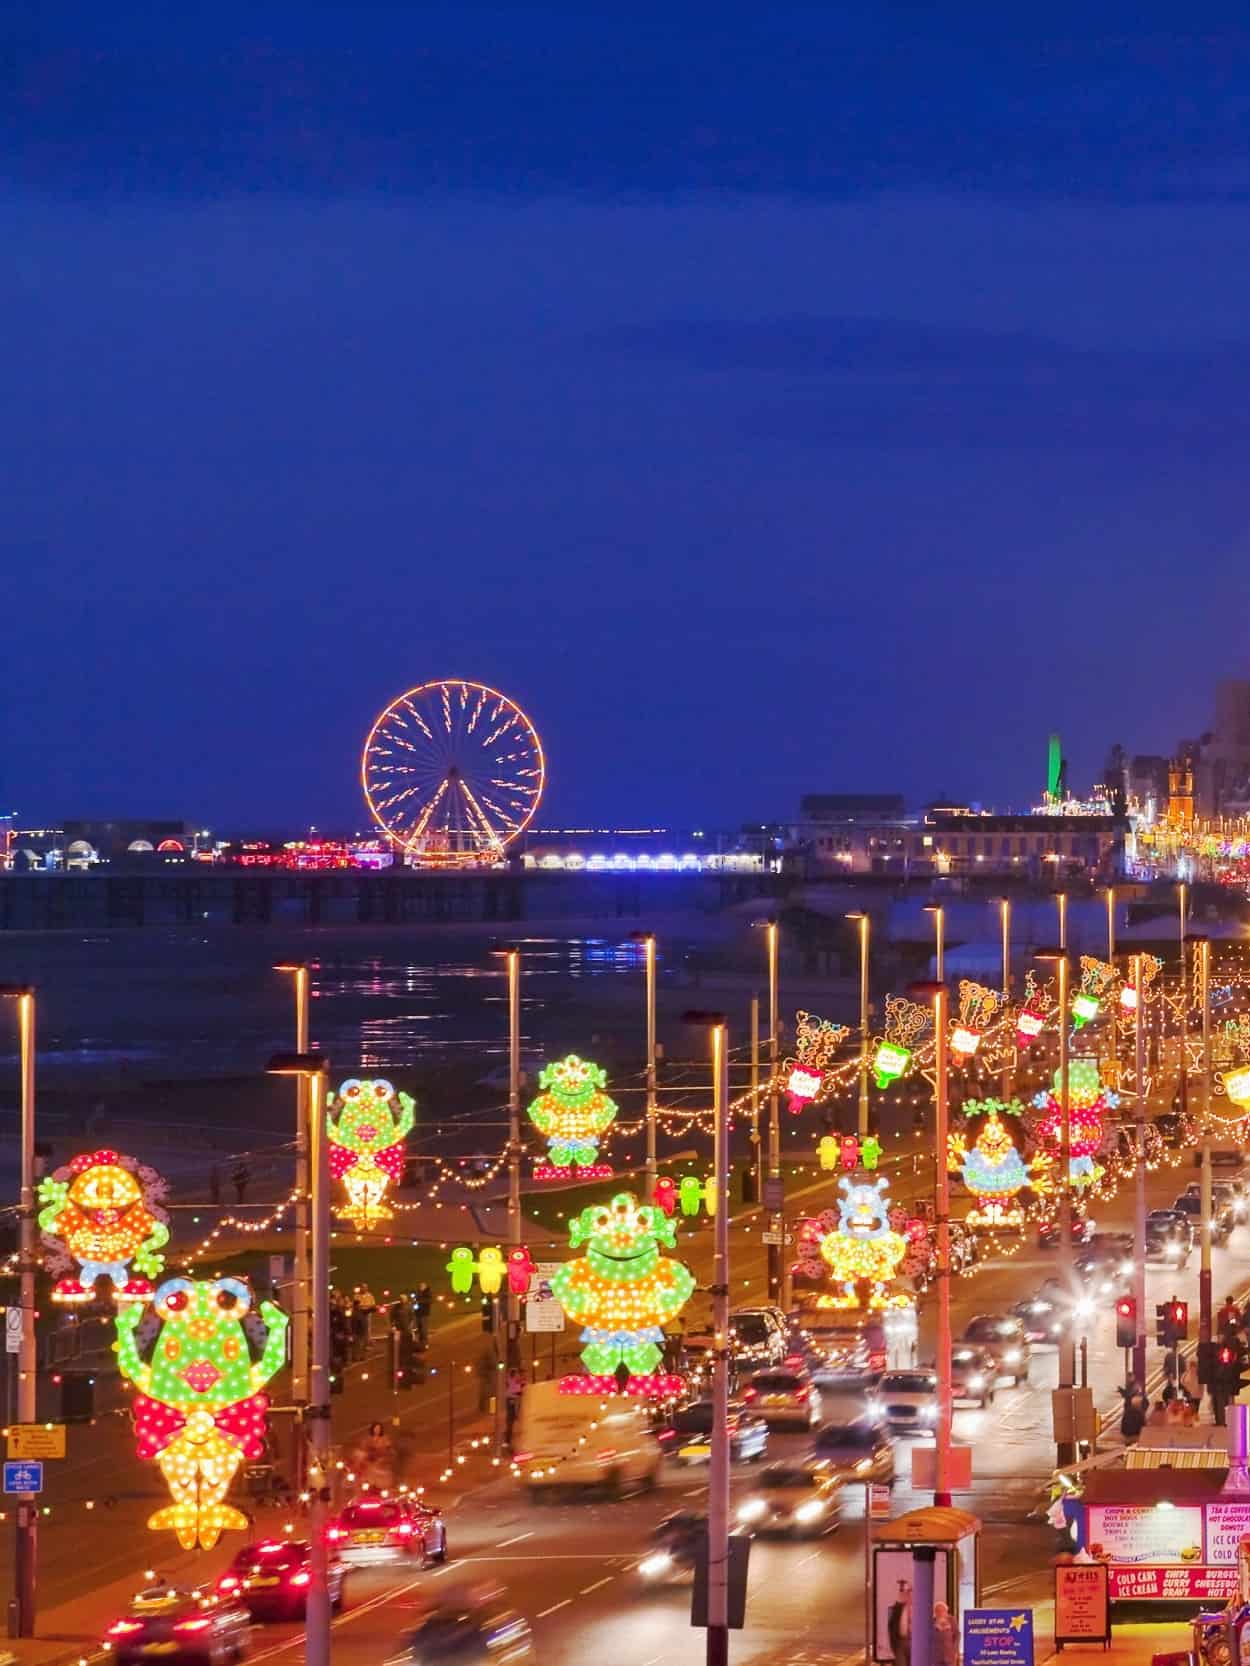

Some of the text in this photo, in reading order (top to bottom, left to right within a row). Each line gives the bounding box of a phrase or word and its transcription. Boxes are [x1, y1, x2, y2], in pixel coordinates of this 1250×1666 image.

[1213, 1536, 1225, 1544] ICE
[1213, 1550, 1232, 1559] COLD
[1117, 1573, 1136, 1585] COLD
[1137, 1570, 1157, 1583] CANS
[1165, 1570, 1189, 1578] CHIPS
[1163, 1579, 1190, 1587] CURRY
[1118, 1583, 1158, 1597] ICE CREAM
[1162, 1588, 1190, 1597] GRAVY
[1207, 1588, 1225, 1597] HOT
[984, 1635, 1015, 1647] STOP
